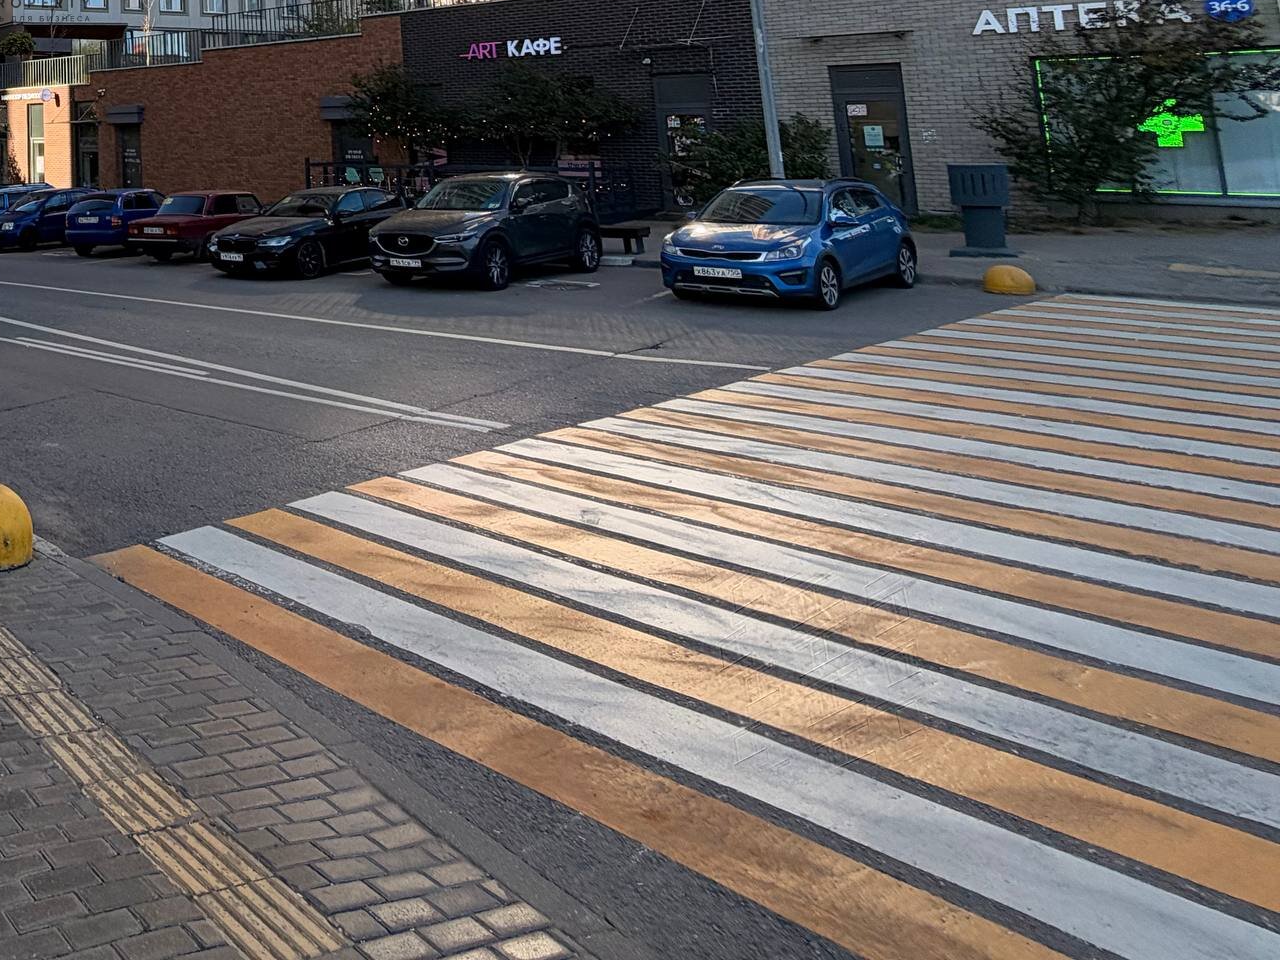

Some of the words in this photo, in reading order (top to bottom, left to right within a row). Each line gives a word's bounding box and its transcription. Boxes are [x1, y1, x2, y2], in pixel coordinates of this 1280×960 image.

[1207, 0, 1250, 14] 36-6
[463, 41, 500, 60] ART
[506, 36, 562, 57] КАФЕ
